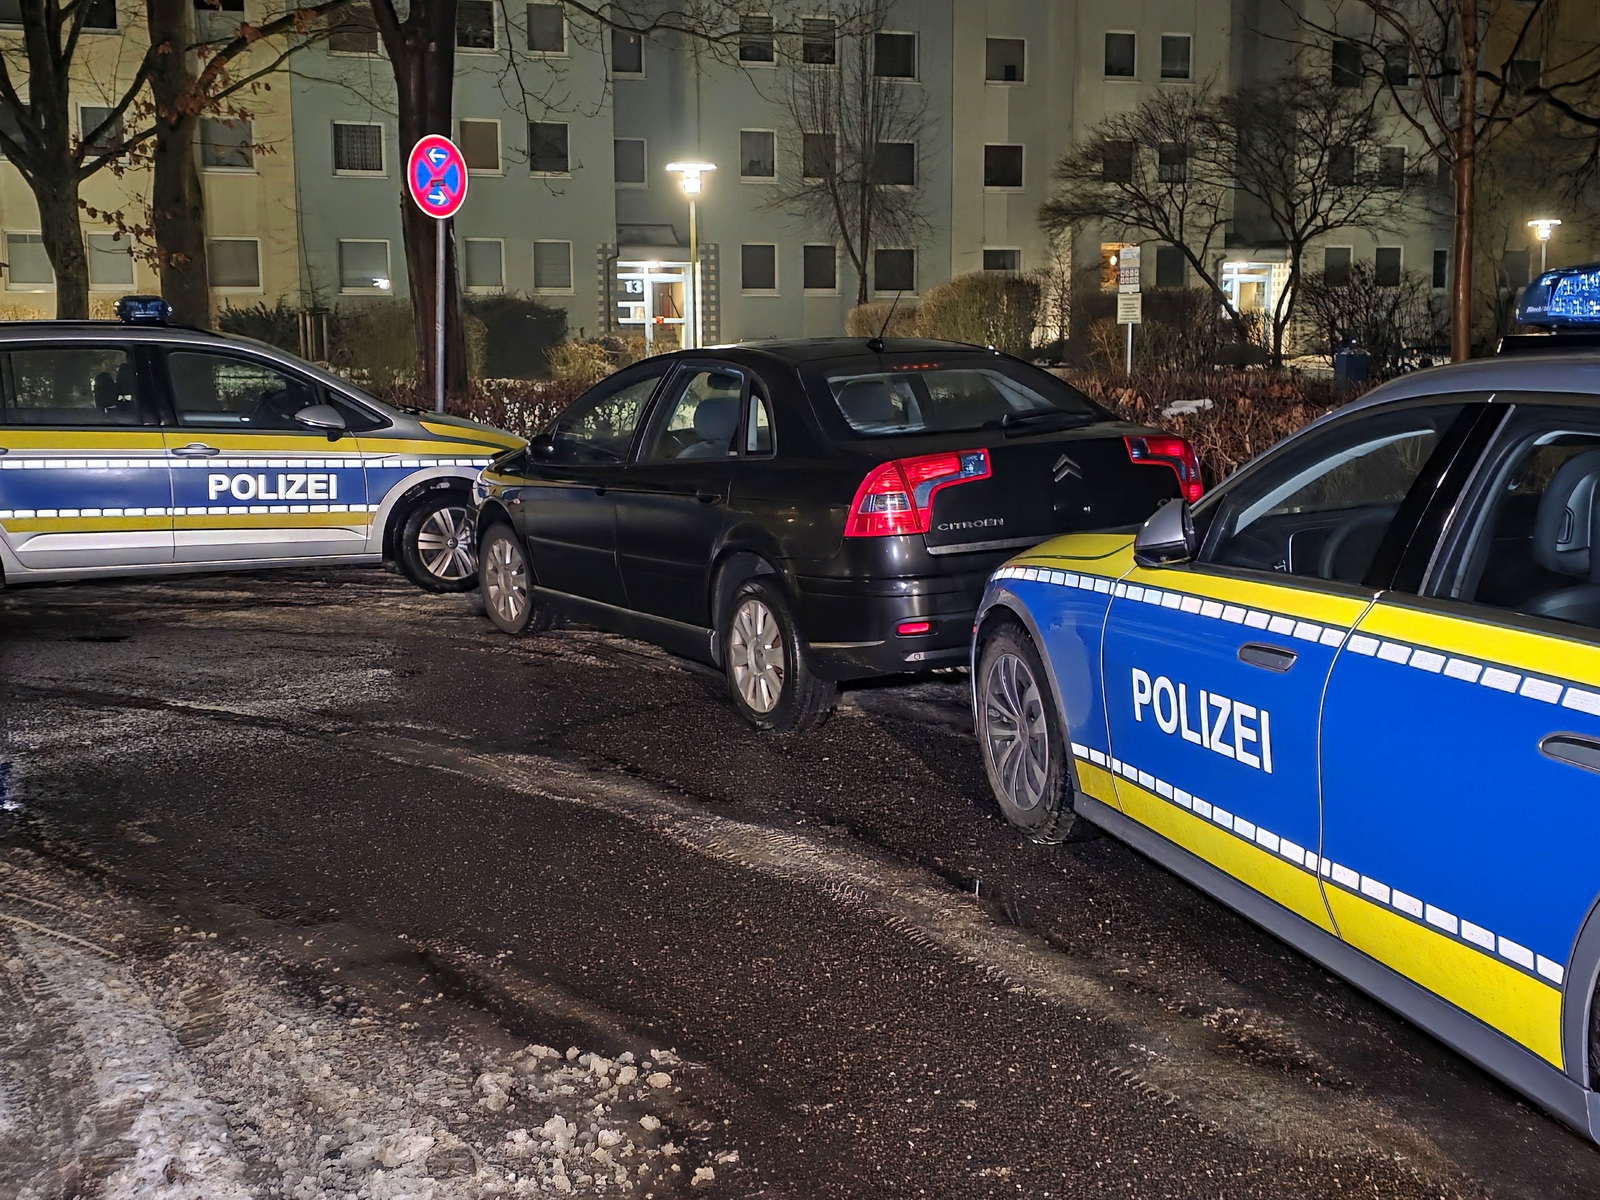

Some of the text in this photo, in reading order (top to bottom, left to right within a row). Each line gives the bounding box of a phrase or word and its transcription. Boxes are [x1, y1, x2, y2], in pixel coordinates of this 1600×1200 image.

[624, 280, 643, 293] 13
[207, 473, 338, 501] POLIZEI
[1131, 667, 1274, 774] POLIZEI
